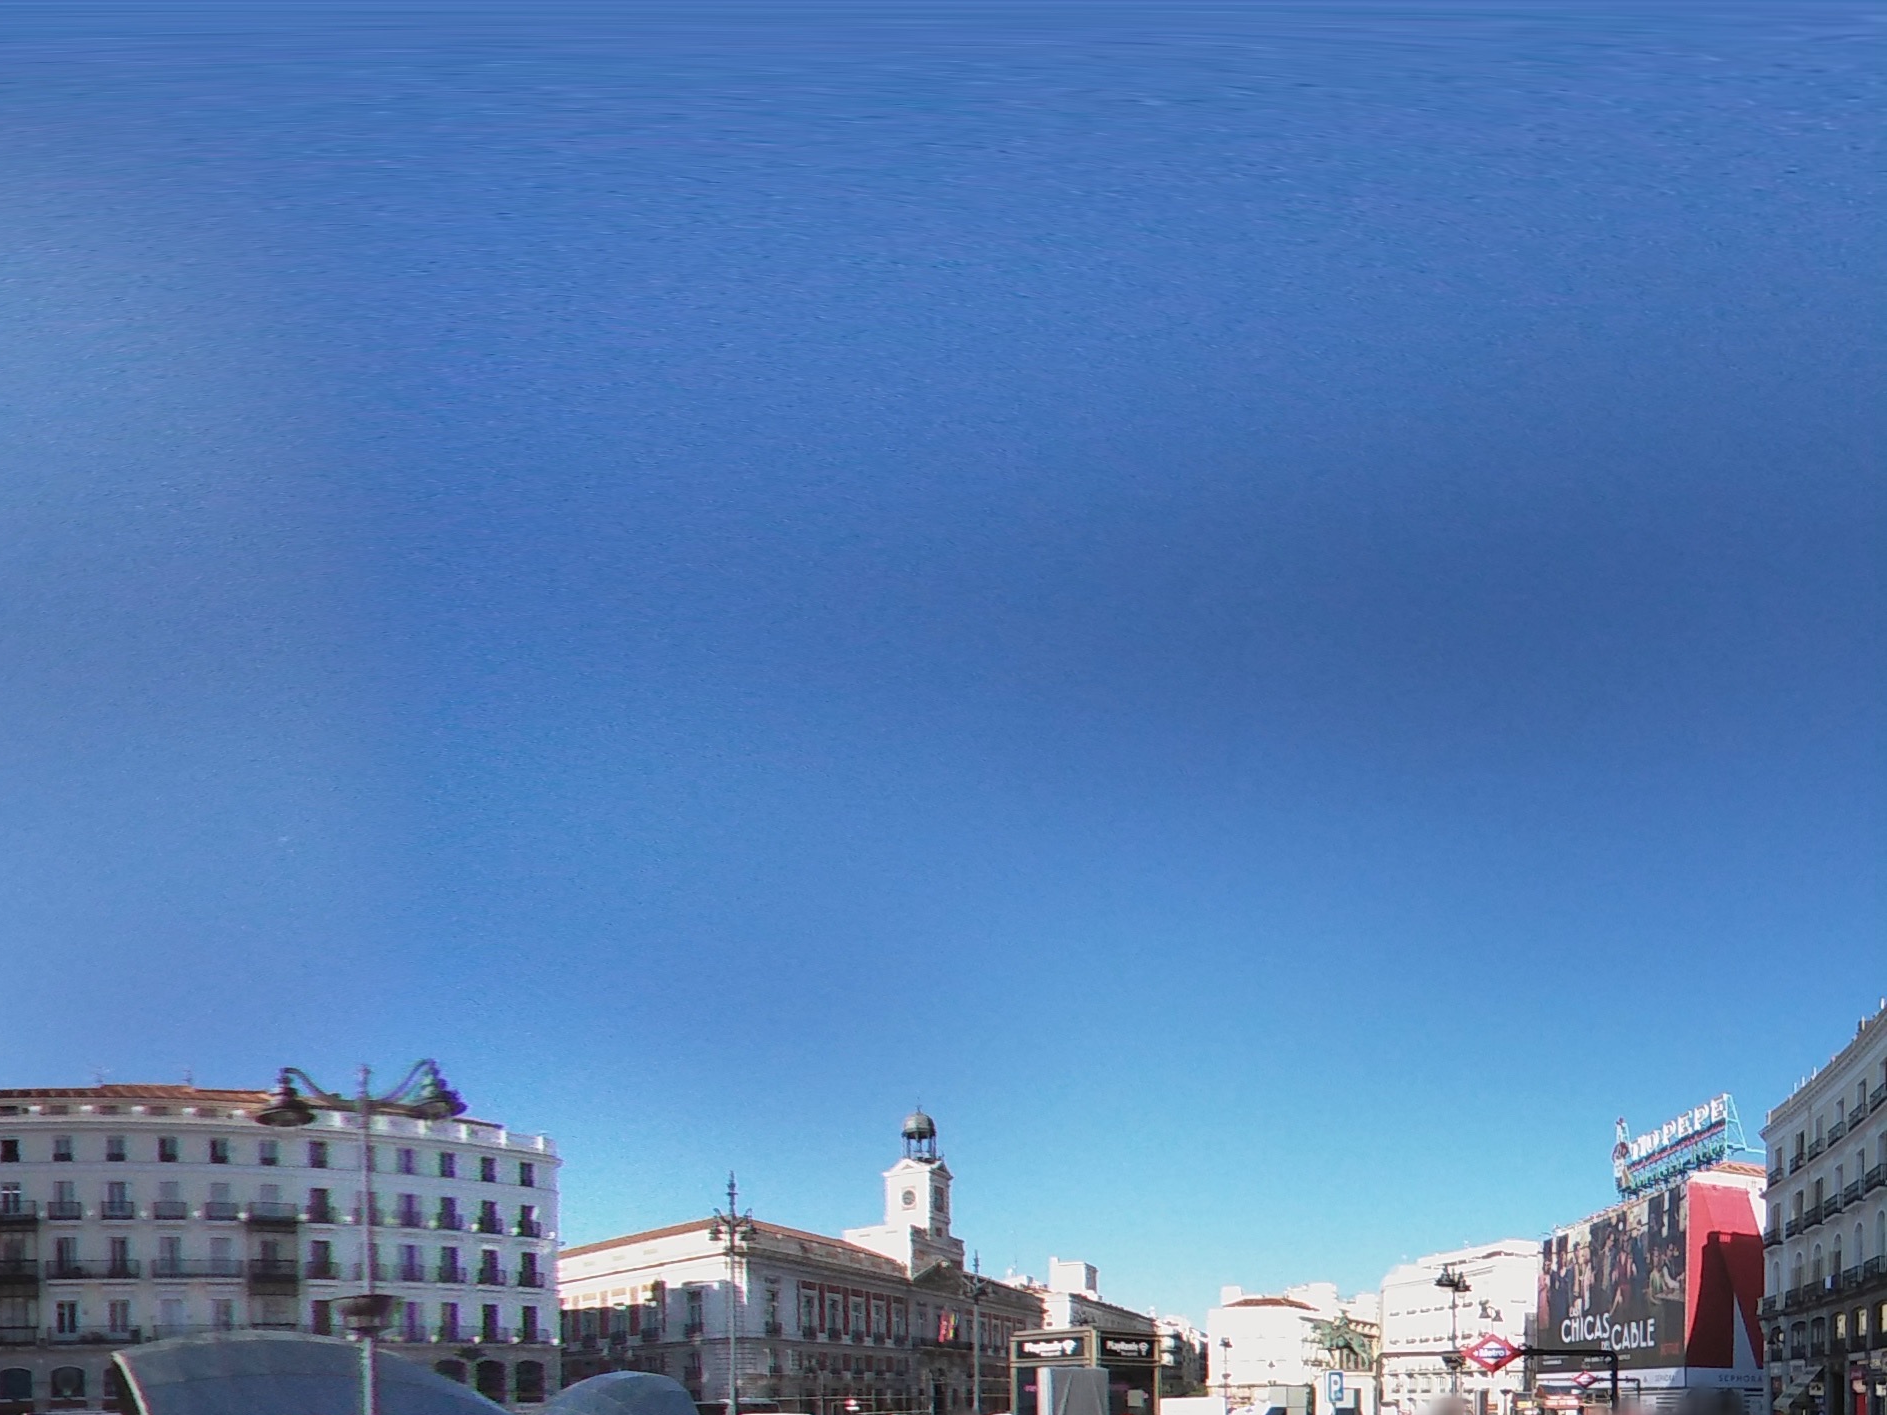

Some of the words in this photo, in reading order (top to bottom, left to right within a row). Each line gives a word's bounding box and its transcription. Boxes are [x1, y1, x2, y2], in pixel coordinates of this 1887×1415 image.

[1662, 1098, 1726, 1145] PEPE
[1561, 1313, 1611, 1344] CHICAS
[1611, 1318, 1656, 1351] CABLE
[1478, 1349, 1505, 1357] Metro
[1331, 1374, 1342, 1400] P
[1718, 1374, 1763, 1383] SEPHORA
